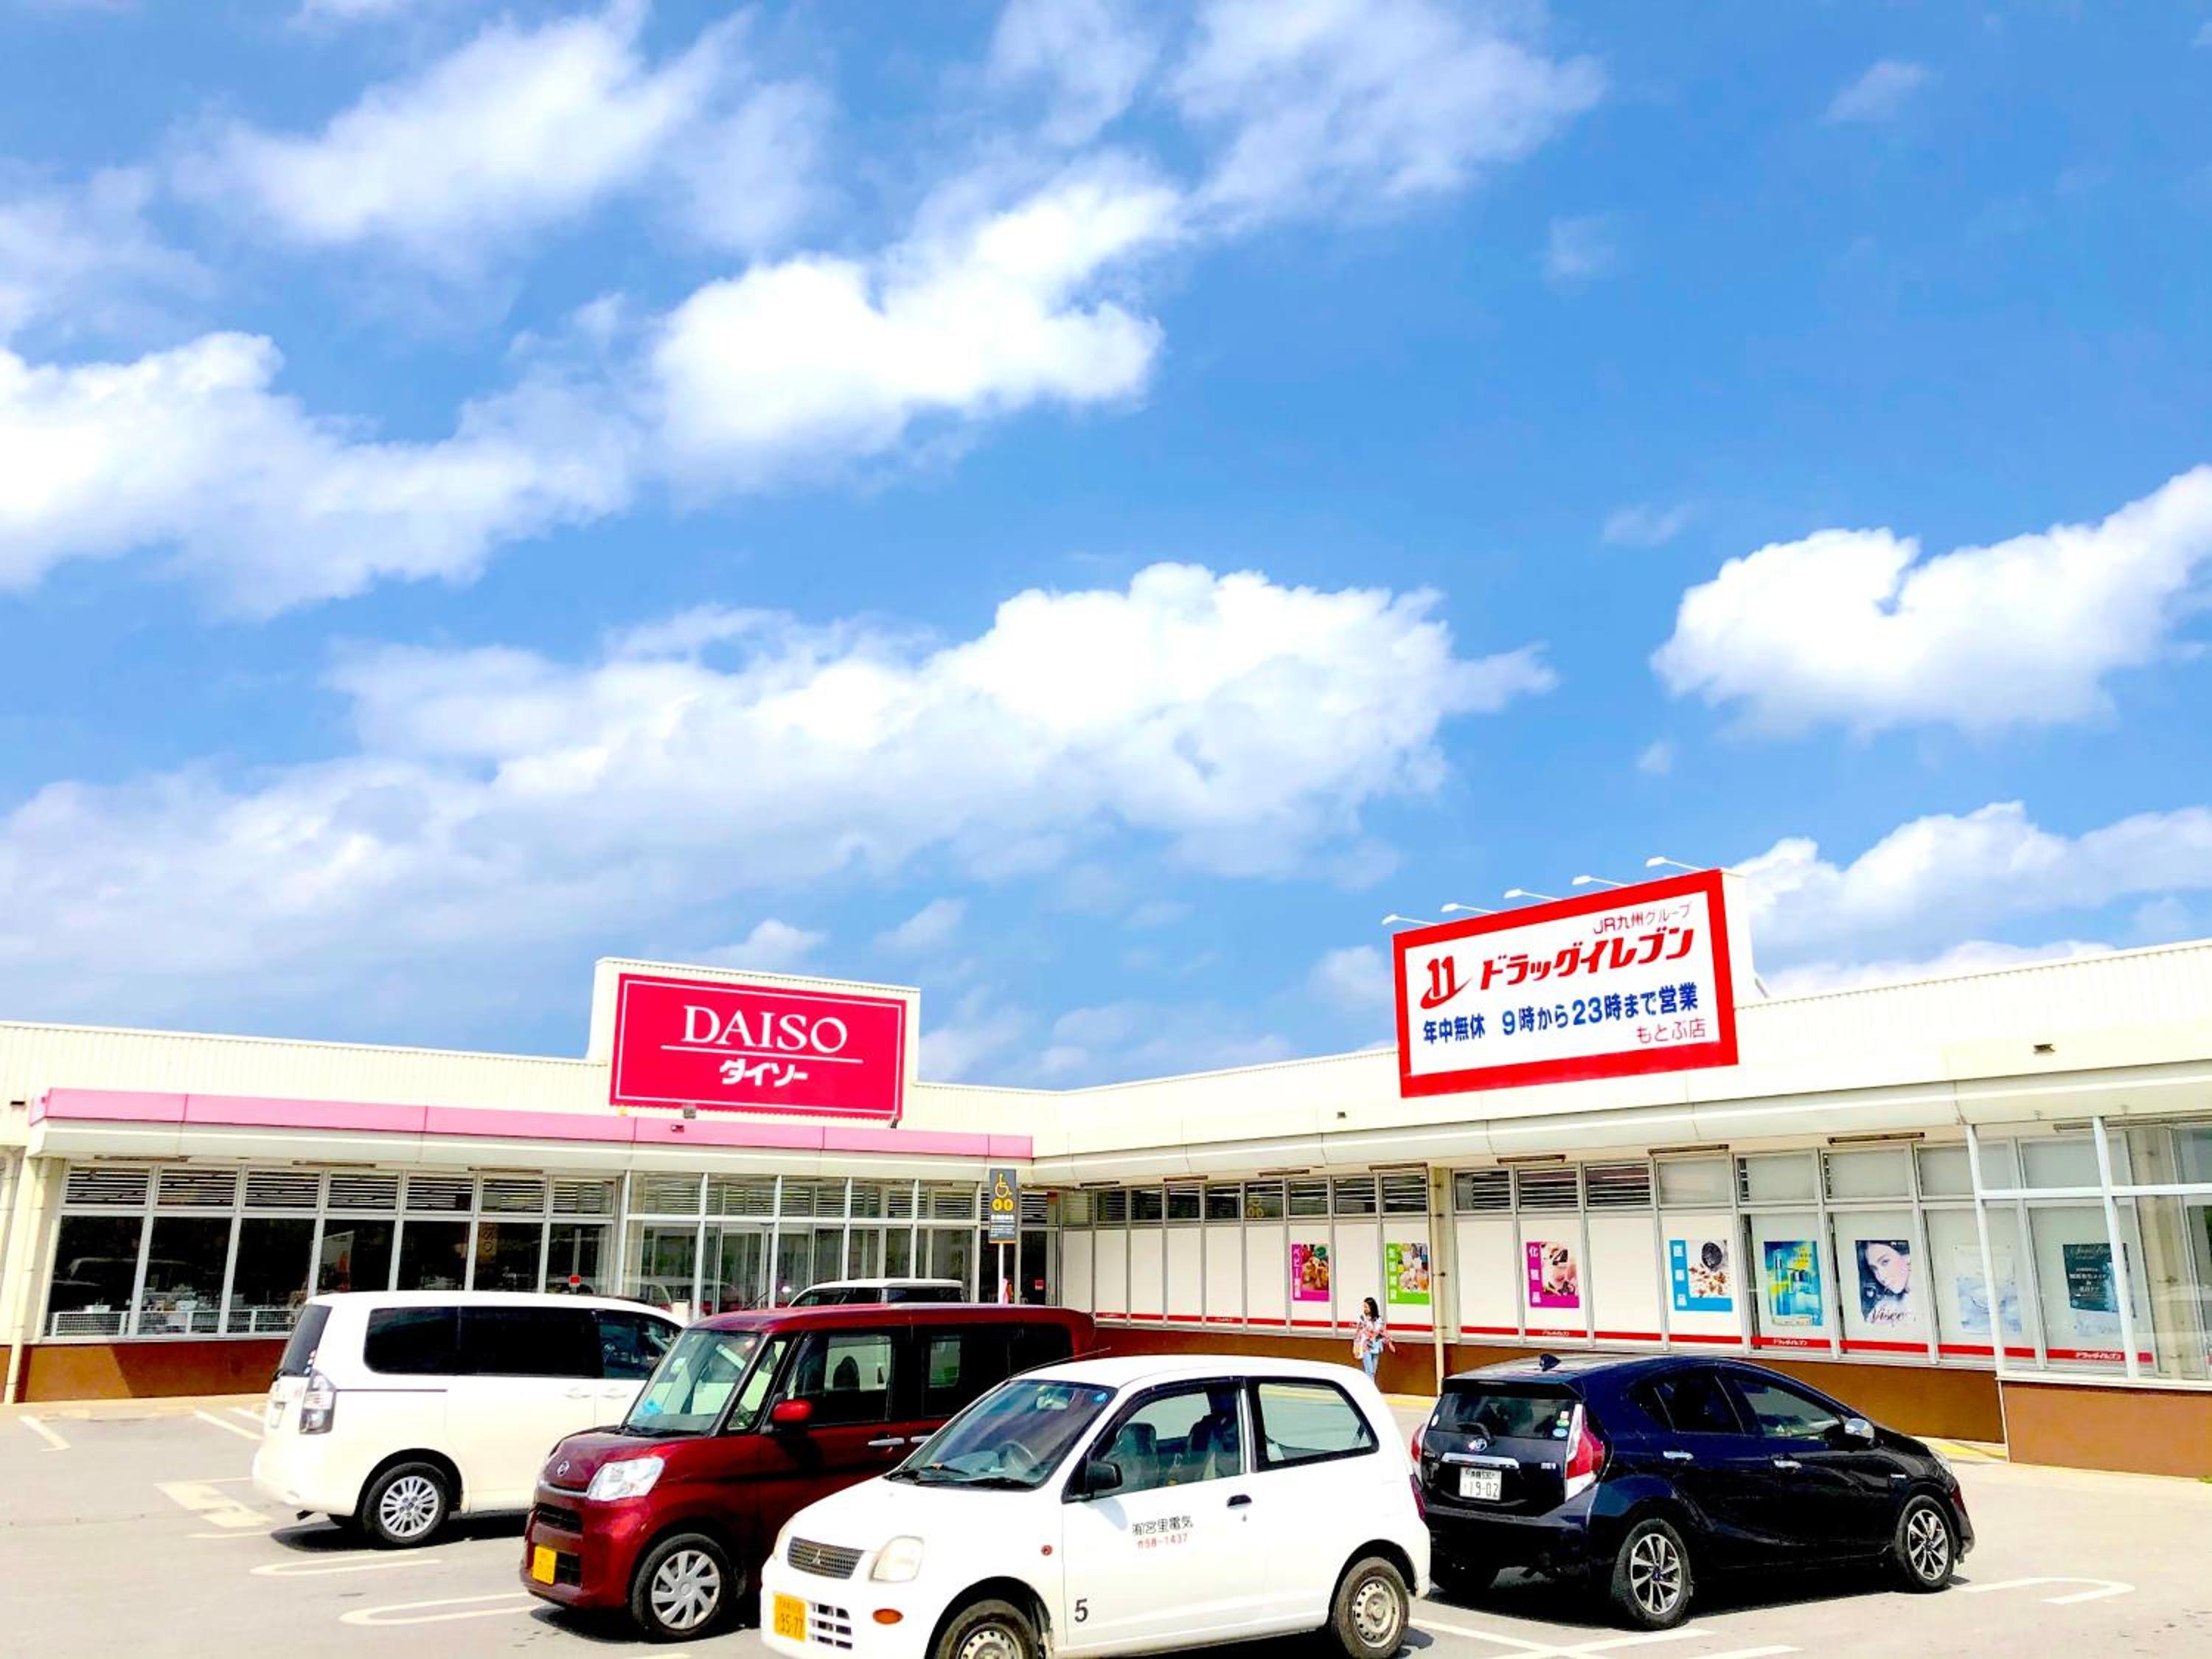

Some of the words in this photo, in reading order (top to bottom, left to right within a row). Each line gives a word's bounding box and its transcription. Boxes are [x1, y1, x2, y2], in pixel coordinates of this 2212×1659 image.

[1593, 902, 1691, 935] JR九州グループ
[1480, 928, 1694, 990] ドラッグイレブン
[1423, 1013, 1486, 1044] 年中無休
[1501, 981, 1697, 1036] 9時から23時まで営業
[681, 1005, 848, 1054] DAISO
[1636, 1018, 1706, 1044] もとぶ店
[719, 1058, 808, 1087] ダイソー
[1074, 1598, 1088, 1623] 5
